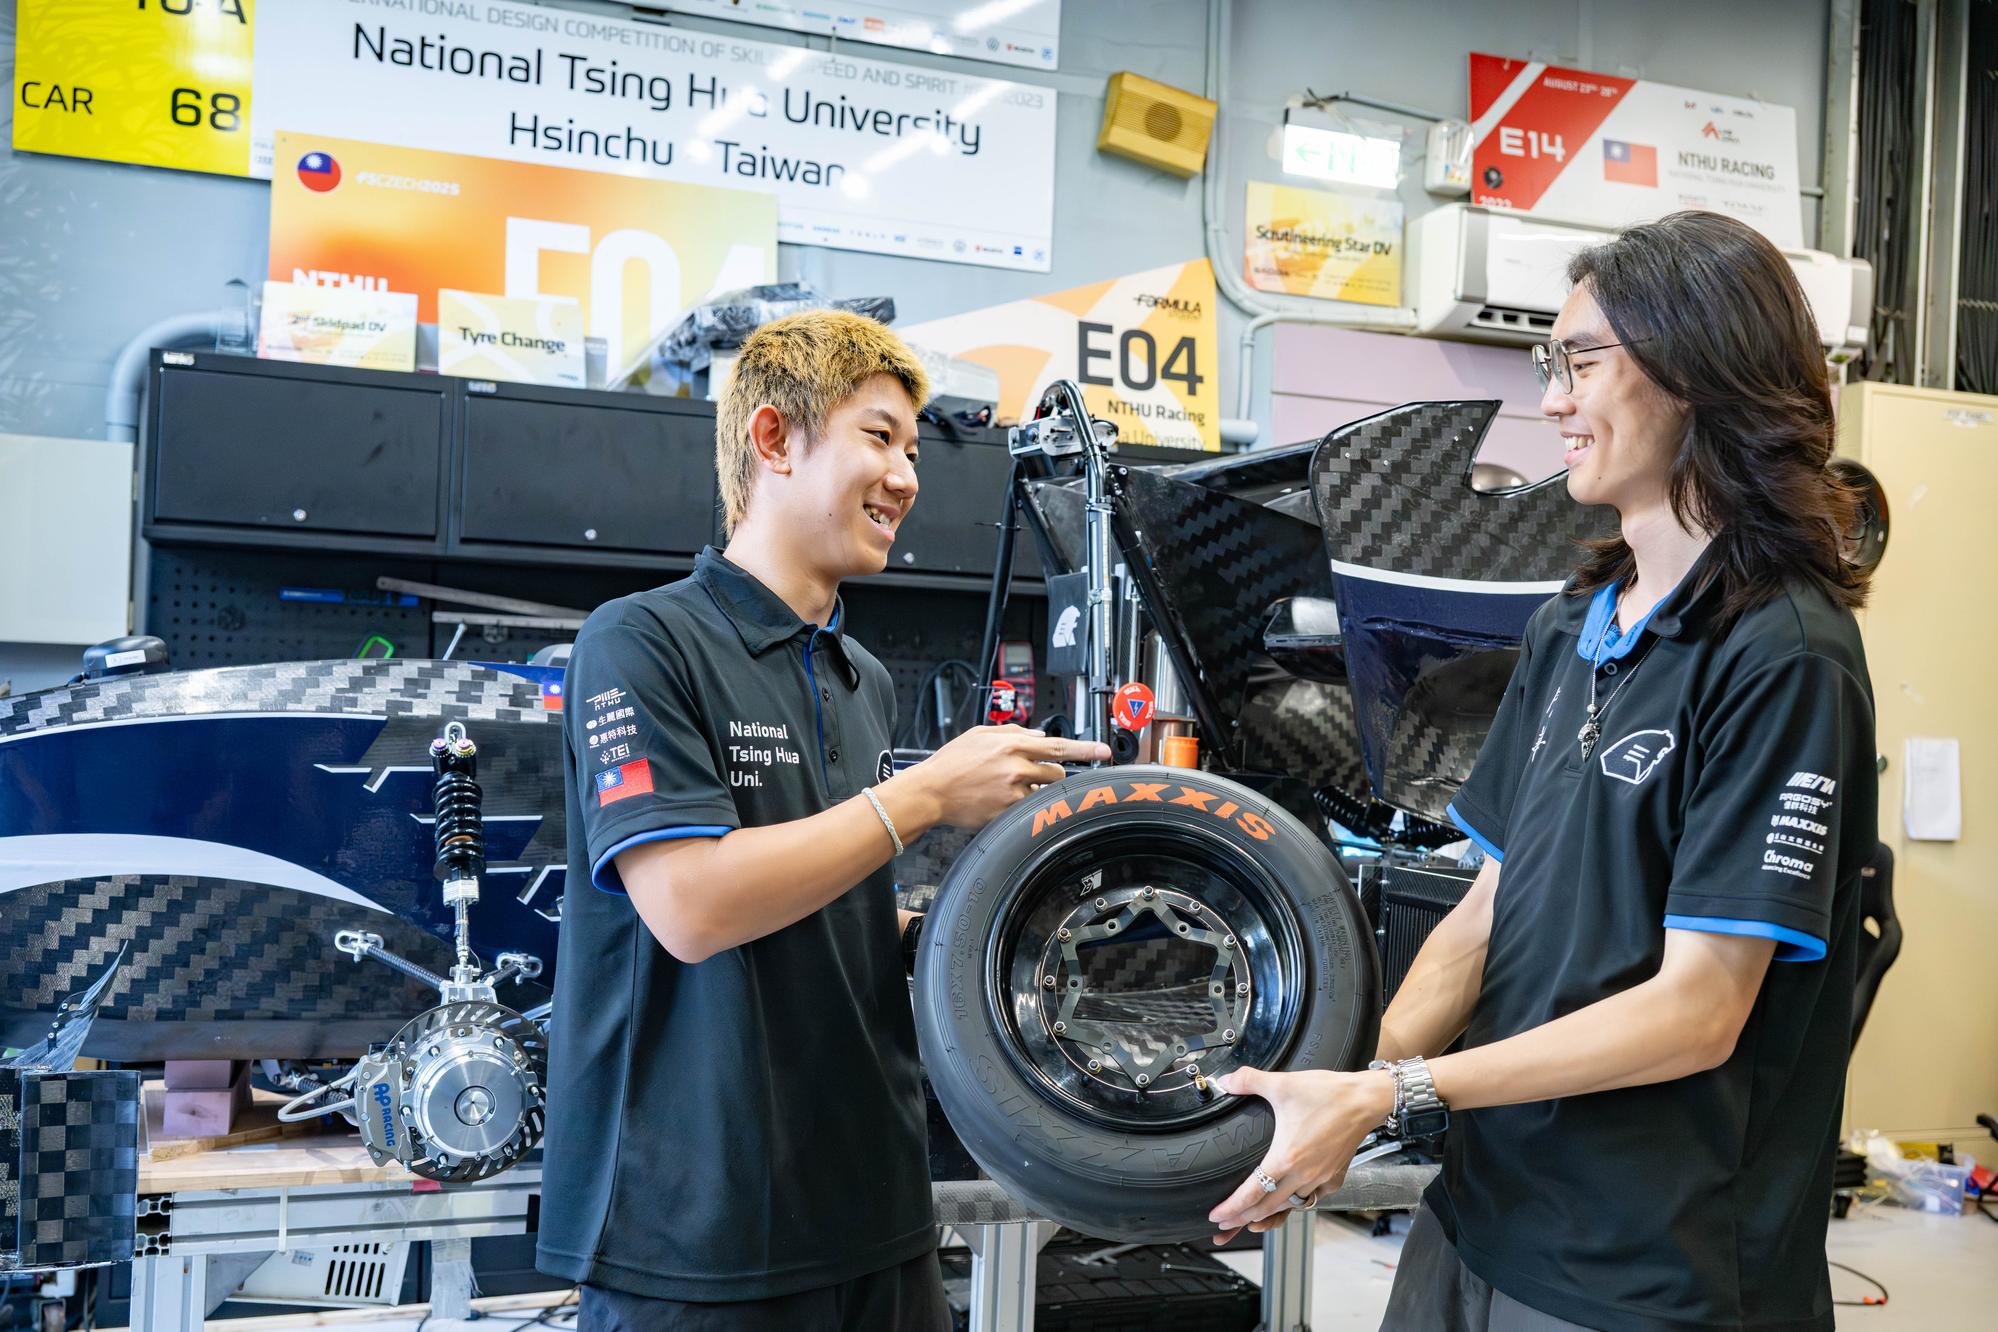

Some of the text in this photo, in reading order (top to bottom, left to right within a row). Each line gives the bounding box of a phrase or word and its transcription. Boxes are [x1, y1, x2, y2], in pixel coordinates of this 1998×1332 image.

[488, 7, 558, 33] DESIGN
[564, 19, 695, 54] COMPETITION
[702, 41, 727, 59] OF
[730, 45, 770, 65] SKIL
[808, 57, 857, 80] PEED
[862, 67, 900, 86] AND
[905, 73, 958, 95] SPIRIT
[353, 22, 542, 85] National
[558, 53, 670, 111] Tsing
[785, 88, 980, 155] University
[22, 82, 241, 131] CAR 68
[510, 112, 673, 166] Hsinchu
[1500, 126, 1566, 162] E14
[1679, 151, 1775, 180] NTHU RACING
[1345, 237, 1370, 253] Star
[1373, 241, 1392, 255] DV
[1133, 294, 1202, 313] FORMULA
[458, 327, 566, 353] Tyre Change
[1078, 320, 1204, 396] E04
[1107, 399, 1206, 427] NTHU Racing
[600, 724, 637, 744] 惠特科技
[729, 721, 788, 739] National
[729, 746, 800, 766] Tsing Hua
[730, 770, 763, 787] Uni.
[1031, 783, 1278, 841] MAXXIS
[1779, 793, 1829, 808] ARGOSY
[1778, 816, 1828, 836] MAXXIS
[1763, 849, 1814, 872] Chroma
[373, 1083, 395, 1147] AP RACING
